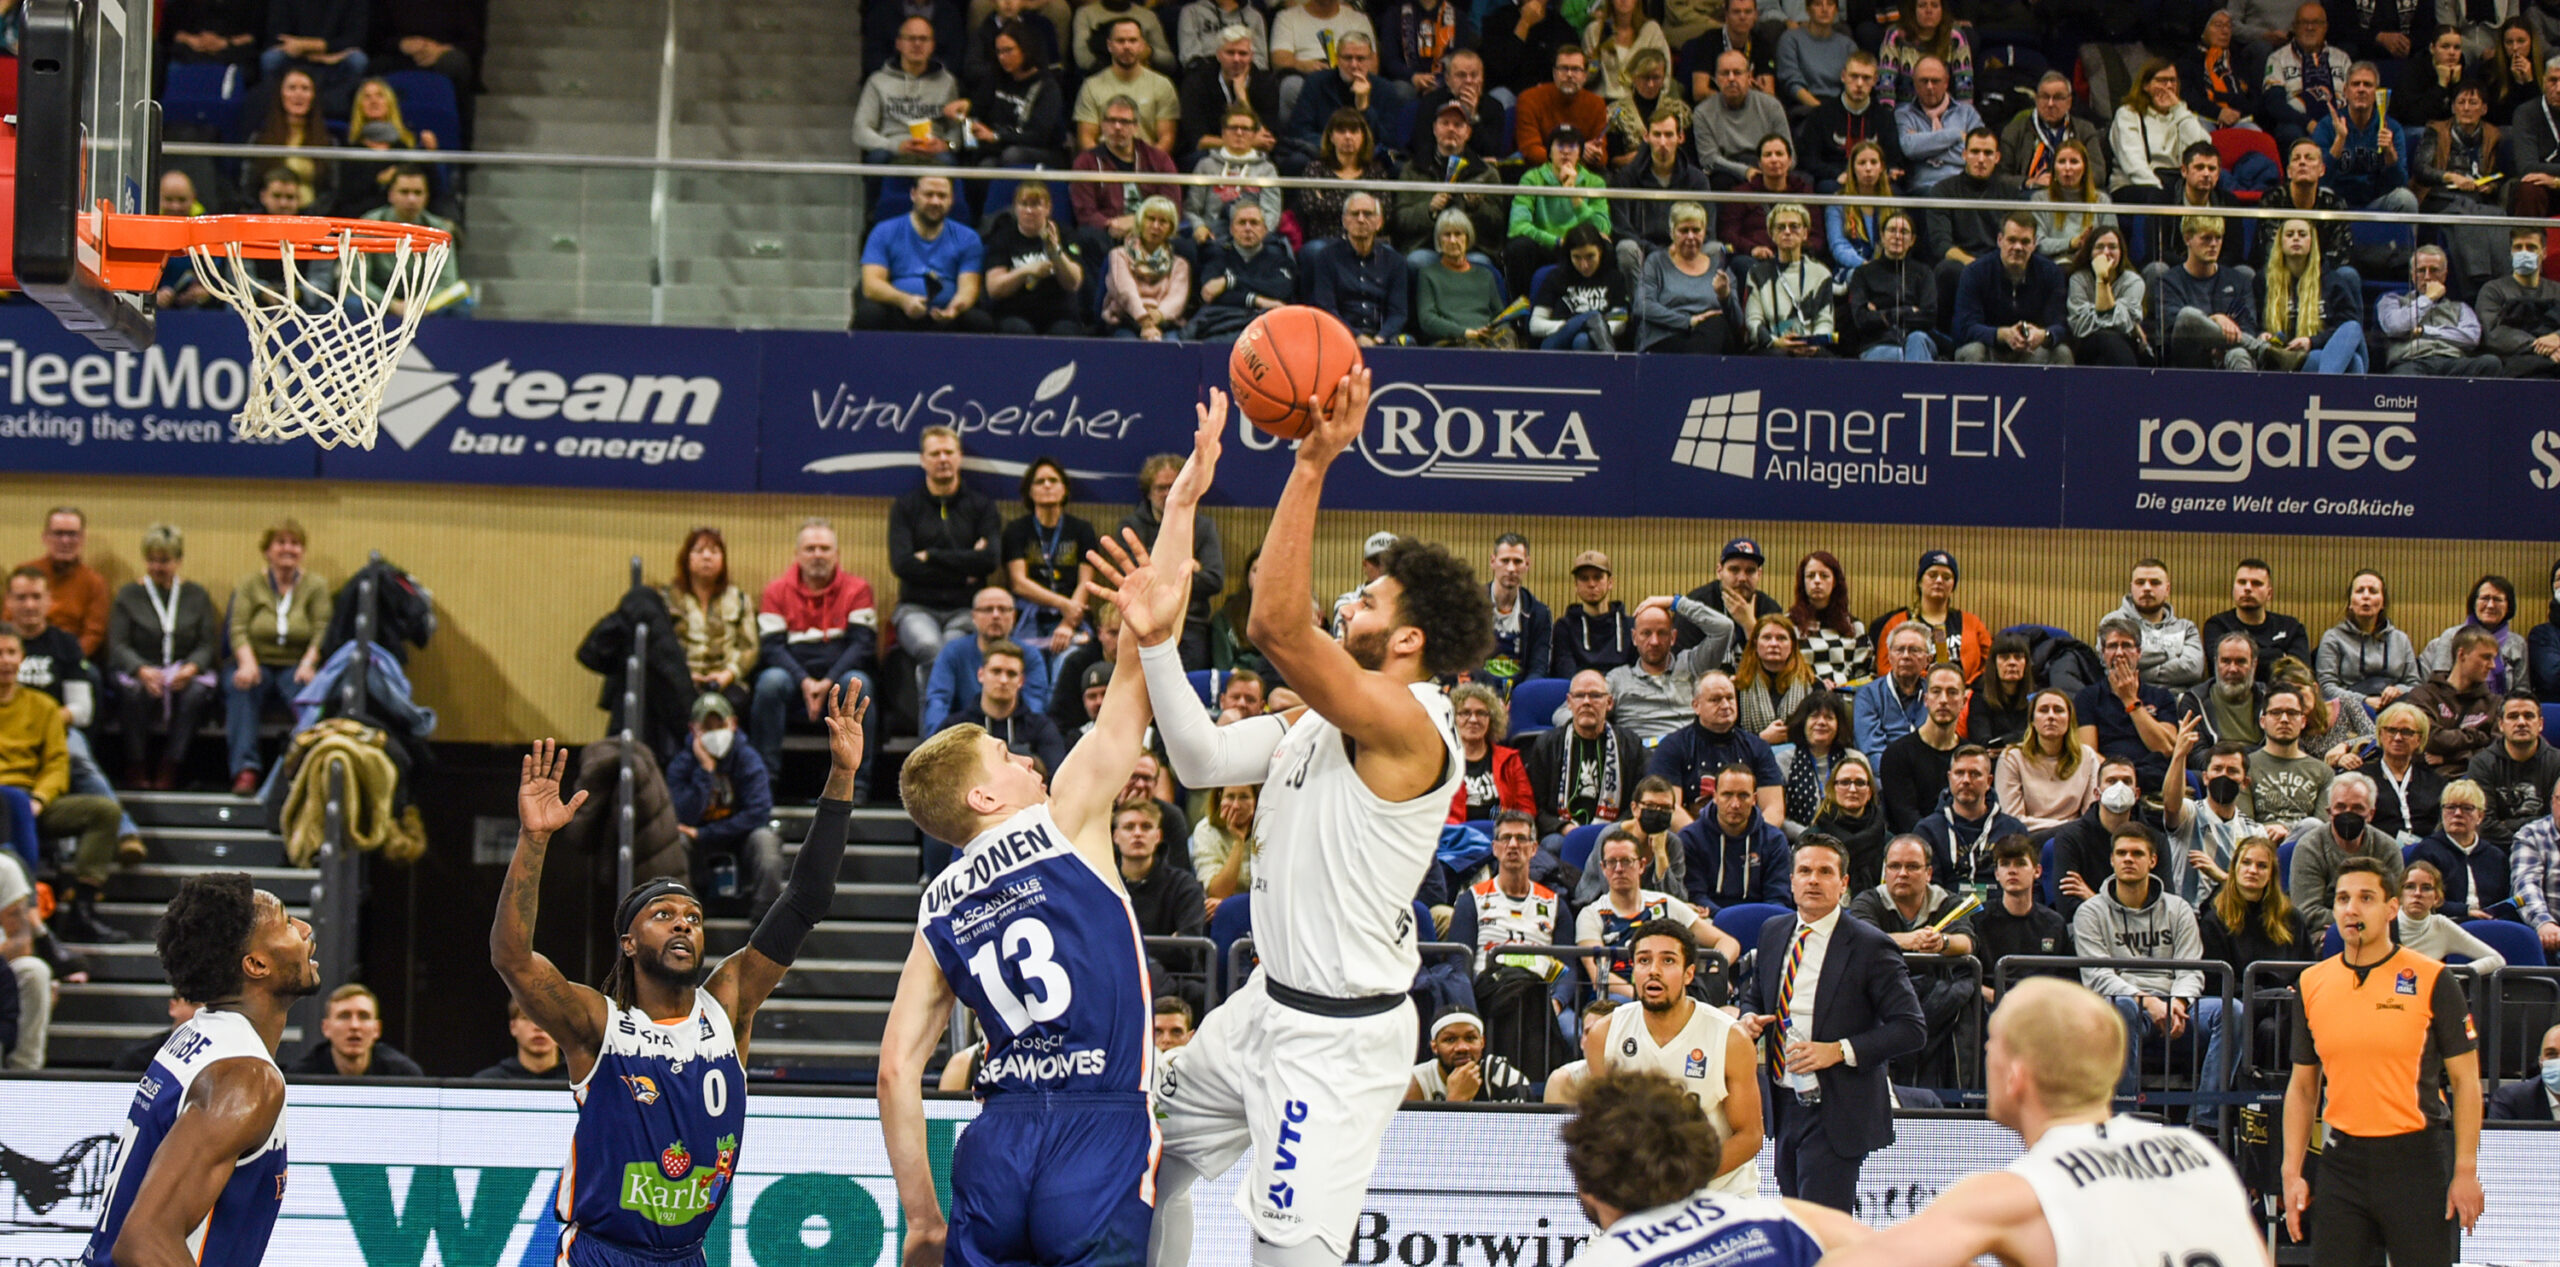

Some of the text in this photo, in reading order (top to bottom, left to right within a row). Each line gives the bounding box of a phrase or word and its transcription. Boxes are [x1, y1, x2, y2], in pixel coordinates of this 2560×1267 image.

[466, 357, 722, 425] team
[2374, 394, 2418, 409] GmbH
[92, 412, 139, 440] the
[142, 417, 222, 443] Seven
[1765, 392, 2027, 459] enerTEK
[2138, 394, 2417, 483] rogatec
[450, 427, 705, 465] bau energie
[1765, 455, 1928, 489] Anlagenbau
[2136, 492, 2415, 517] Die ganze Welt der Großküche
[968, 917, 1072, 1036] 13
[977, 1048, 1106, 1084] SEAWOLVES
[702, 1068, 728, 1118] 0
[1273, 1099, 1308, 1171] VTG
[626, 1173, 709, 1210] Karls
